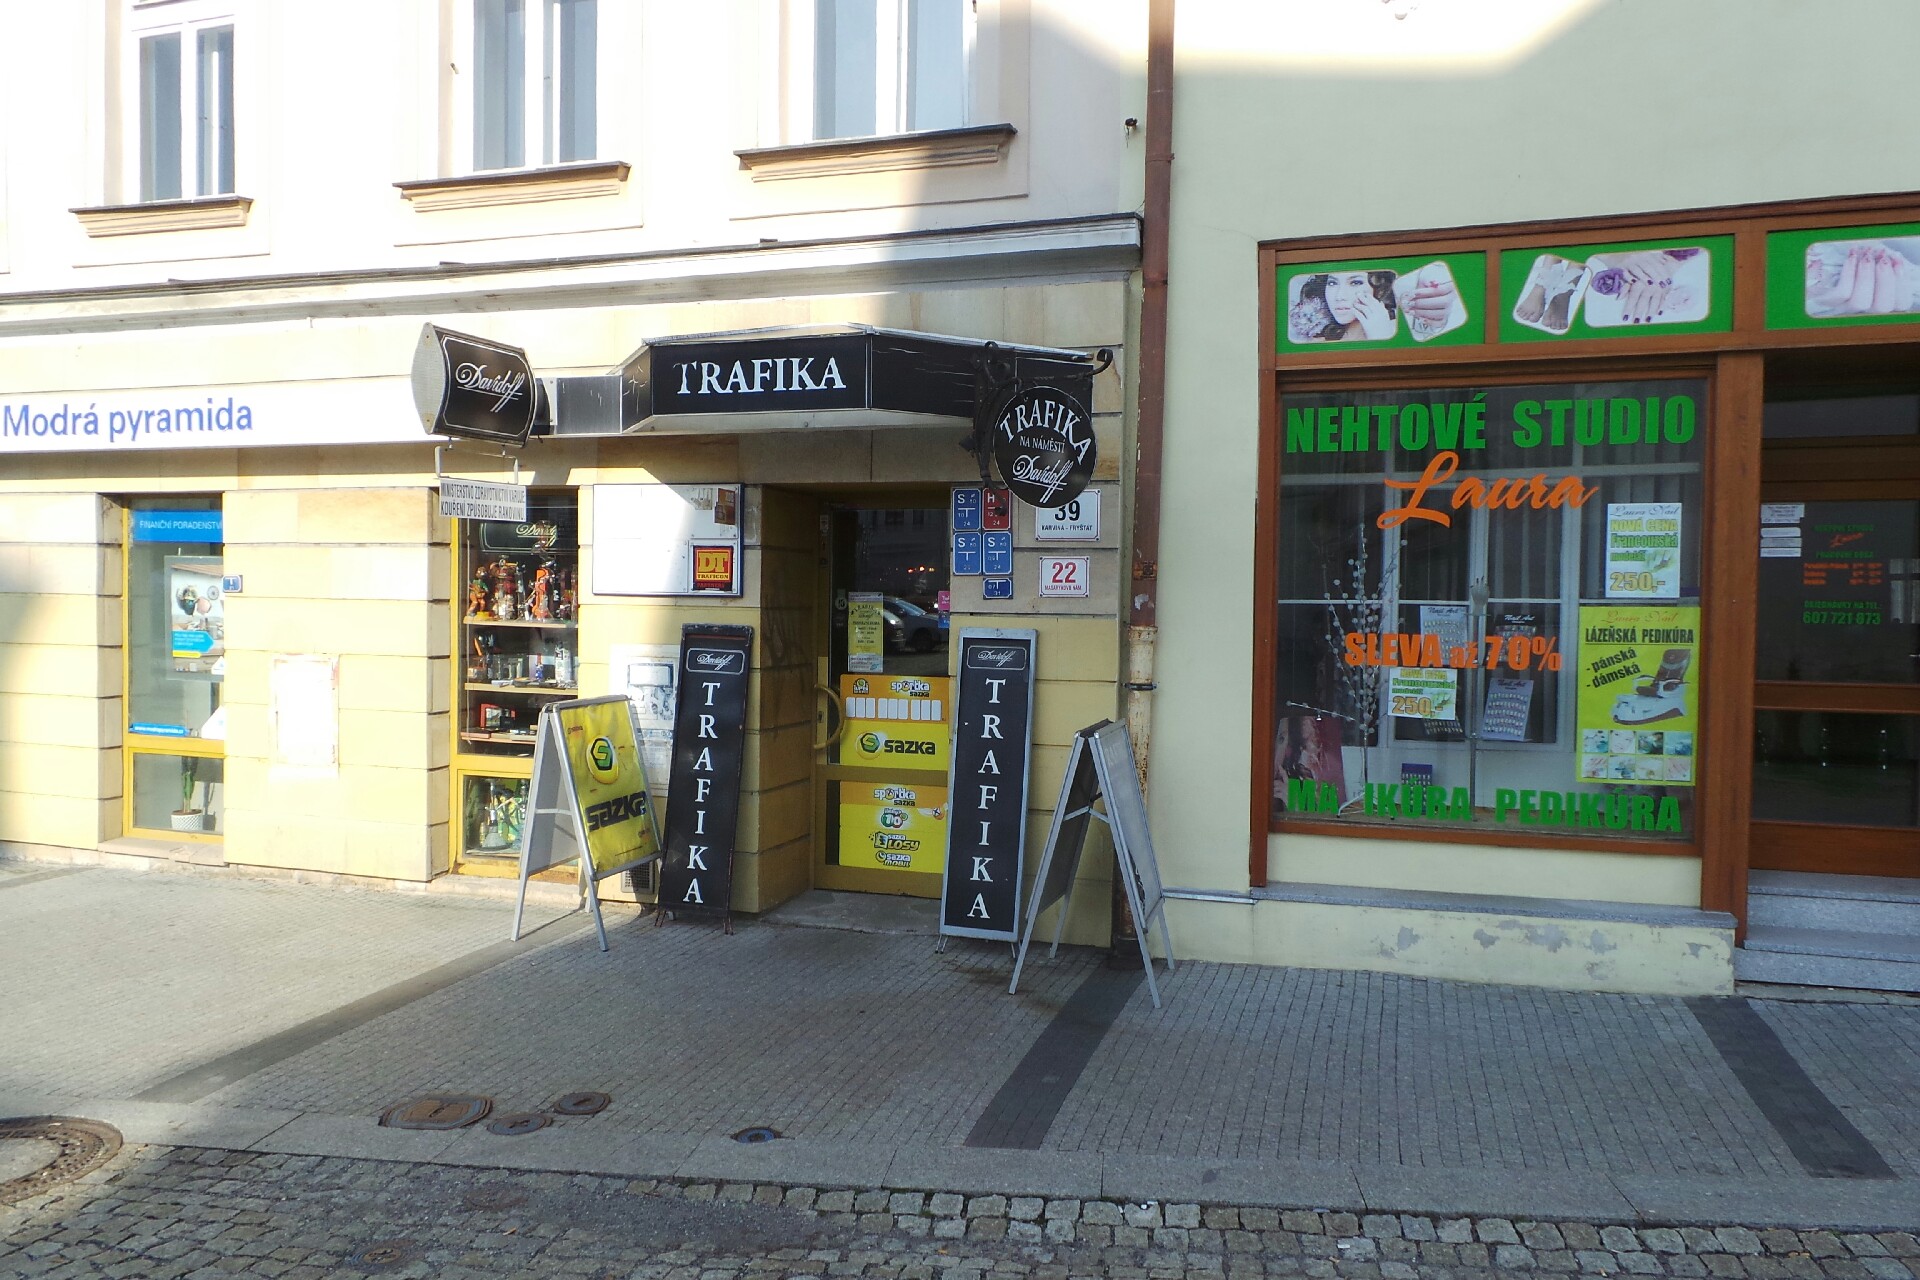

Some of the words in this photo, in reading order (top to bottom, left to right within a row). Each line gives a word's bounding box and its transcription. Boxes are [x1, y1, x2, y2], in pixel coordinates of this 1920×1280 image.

[673, 356, 847, 395] TRAFIKA
[455, 363, 526, 413] Davidoff
[3, 402, 99, 437] Modrá
[108, 397, 253, 443] pyramida
[1286, 393, 1487, 453] NEHTOVÉ
[1513, 395, 1697, 447] STUDIO
[1000, 399, 1092, 465] TRAFIKA
[1020, 435, 1031, 448] NA
[1032, 435, 1066, 454] NÁMĚSTÍ
[1012, 454, 1074, 504] Davidoff
[957, 493, 966, 505] S
[987, 492, 996, 504] H
[1376, 451, 1599, 530] Laura
[440, 499, 466, 516] KOUŘENÍ
[466, 500, 497, 519] ZPŮSOBUJE
[1054, 500, 1081, 521] 39
[1609, 505, 1646, 517] Laura
[1648, 505, 1680, 516] Nail
[139, 519, 172, 529] FINANČNÍ
[1611, 516, 1644, 532] NOVÁ
[1646, 518, 1679, 532] CENA
[957, 537, 966, 548] S
[987, 537, 996, 547] S
[697, 552, 729, 573] DT
[1052, 562, 1077, 584] 22
[1609, 571, 1666, 594] 250,-
[1585, 625, 1638, 643] LÁZEŇSKÁ
[1641, 625, 1695, 644] PEDIKÚRA
[696, 652, 735, 671] Davidoff
[977, 650, 1016, 668] Davidoff
[1344, 631, 1444, 669] SLEVA
[1449, 641, 1479, 669] až
[1483, 634, 1564, 672] 70%
[1591, 647, 1638, 674] pánská
[1592, 661, 1641, 689] dámská
[891, 680, 931, 693] sportka
[1391, 695, 1444, 717] 250,-
[682, 681, 721, 905] TRAFIKA
[873, 787, 917, 801] sportka
[967, 677, 1006, 919] TRAFIKA
[1495, 788, 1683, 832] PEDIKÚRA
[887, 840, 920, 851] LOSY
[886, 853, 911, 862] sazka
